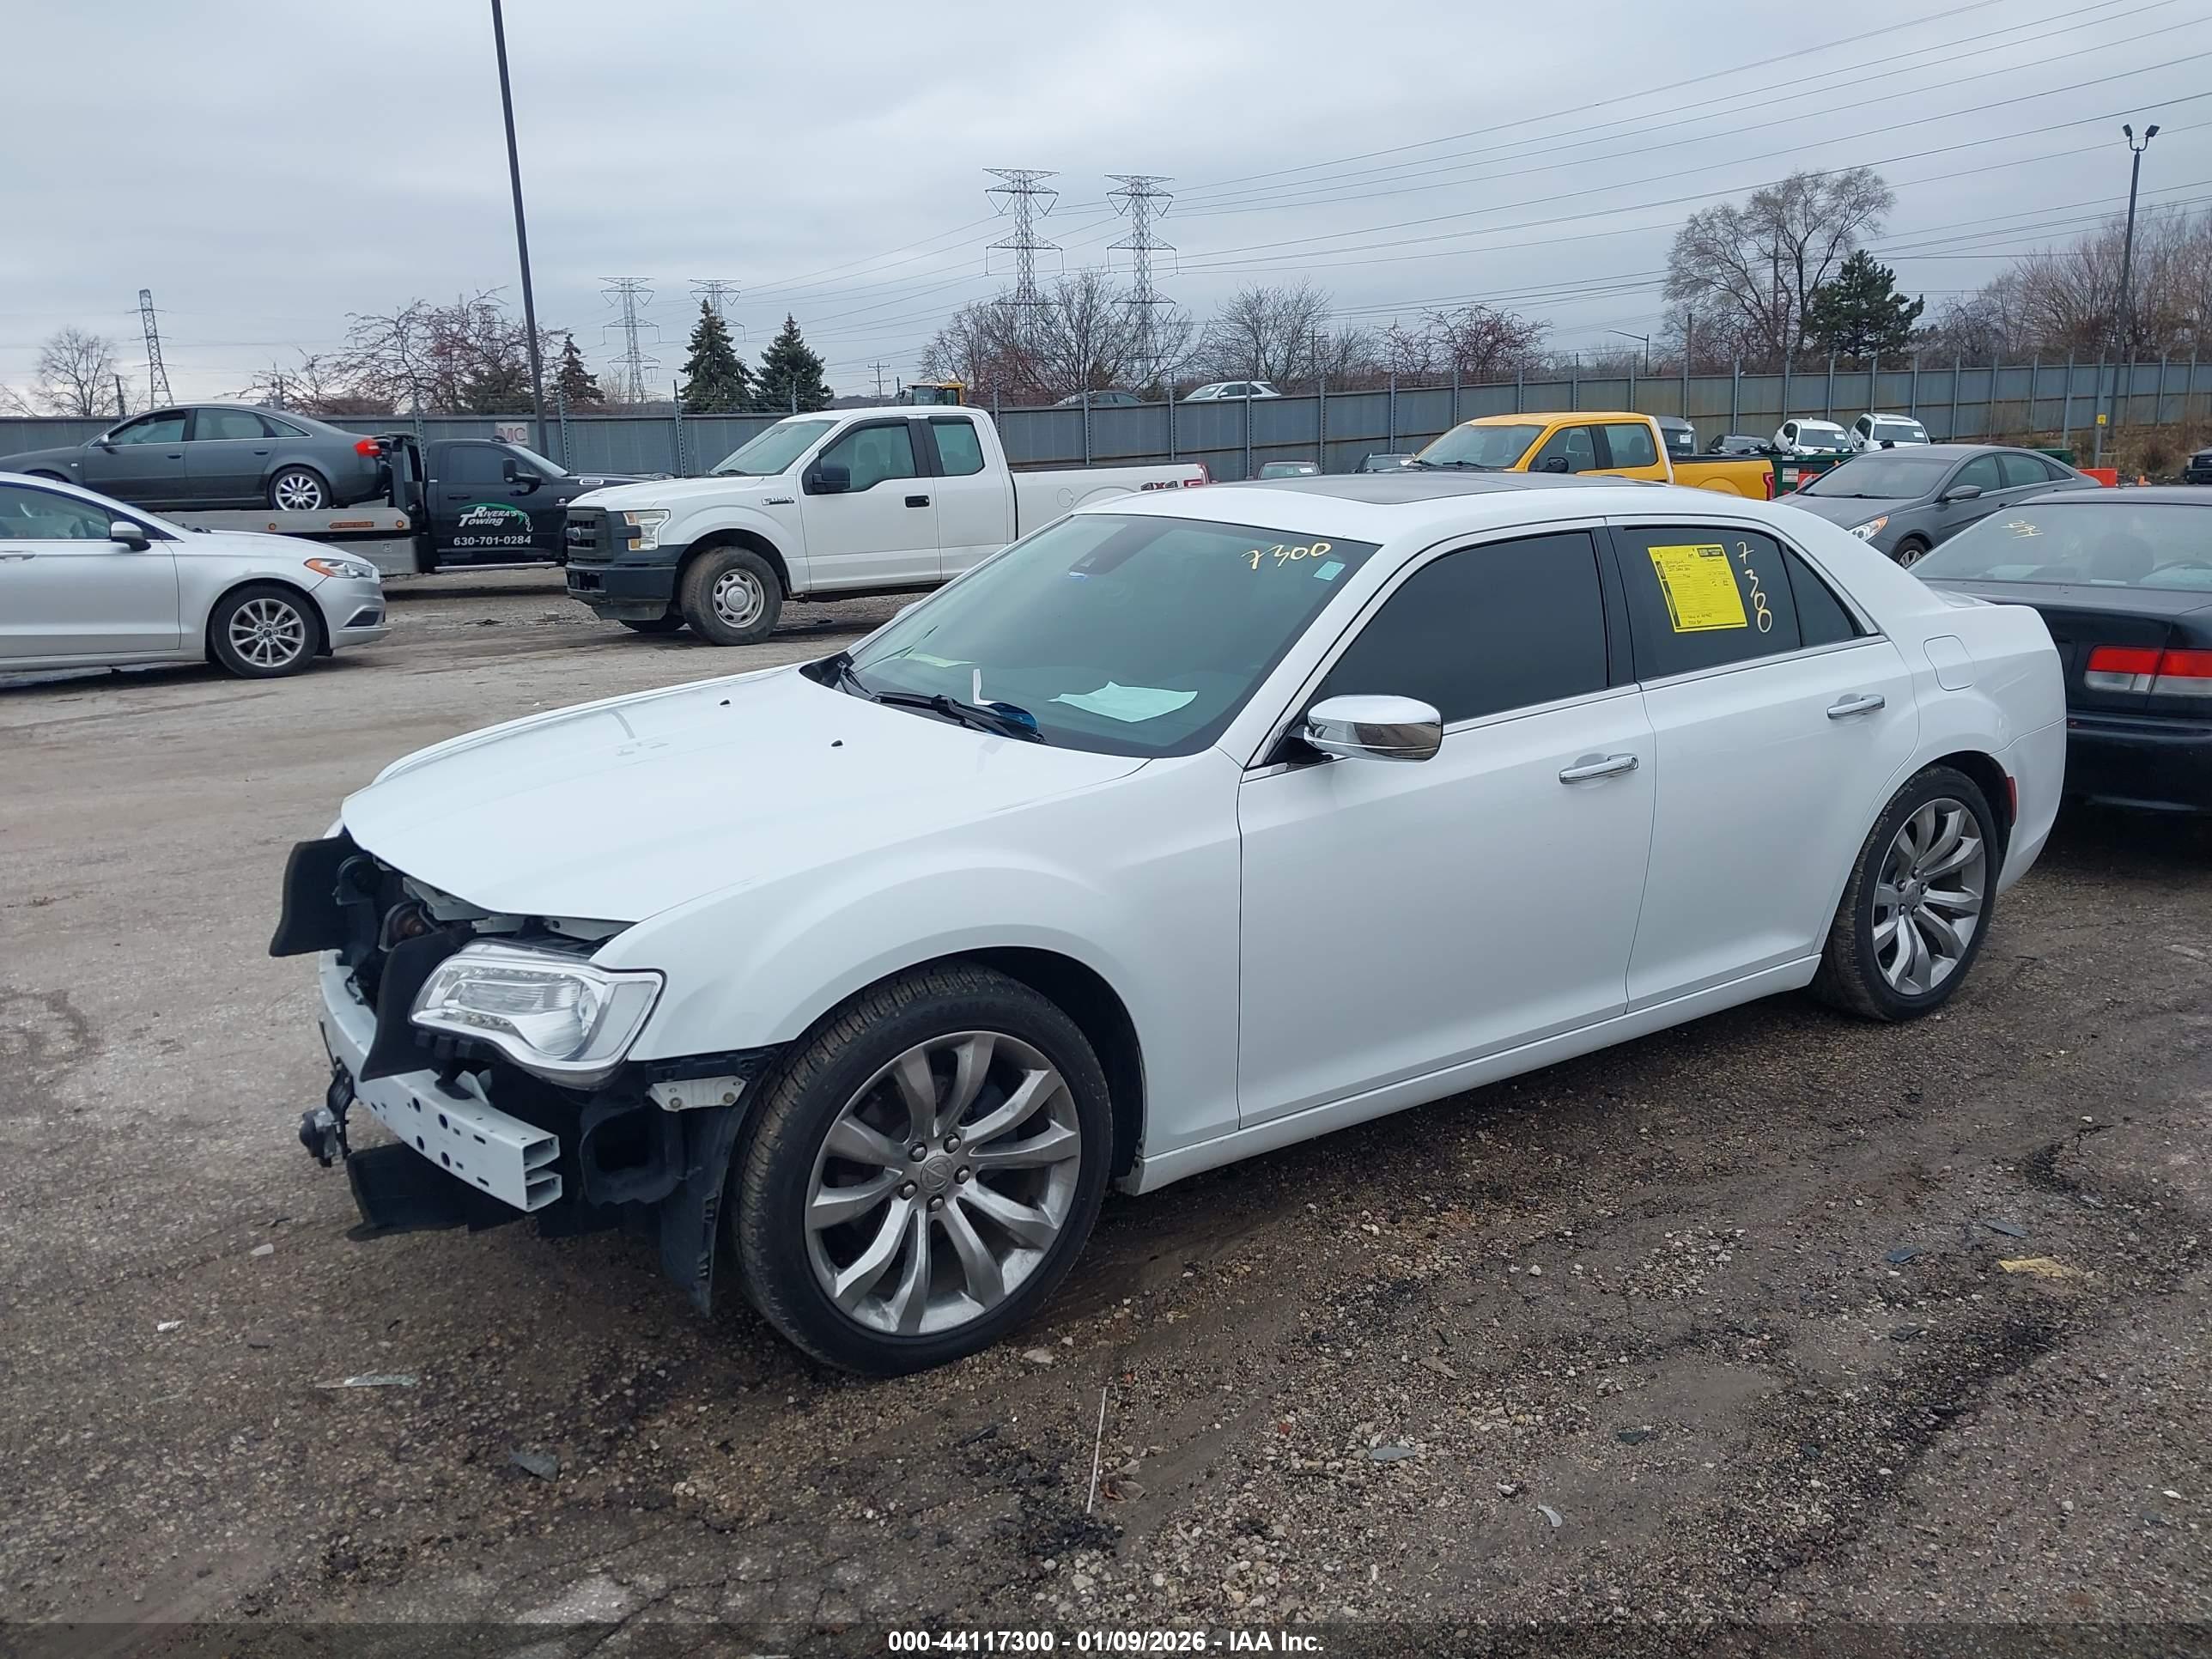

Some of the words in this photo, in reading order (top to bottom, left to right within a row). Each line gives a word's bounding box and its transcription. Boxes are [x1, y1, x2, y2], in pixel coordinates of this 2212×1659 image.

[458, 513, 505, 527] Towing
[453, 535, 532, 546] 630-701-0284
[1240, 541, 1332, 570] 7300
